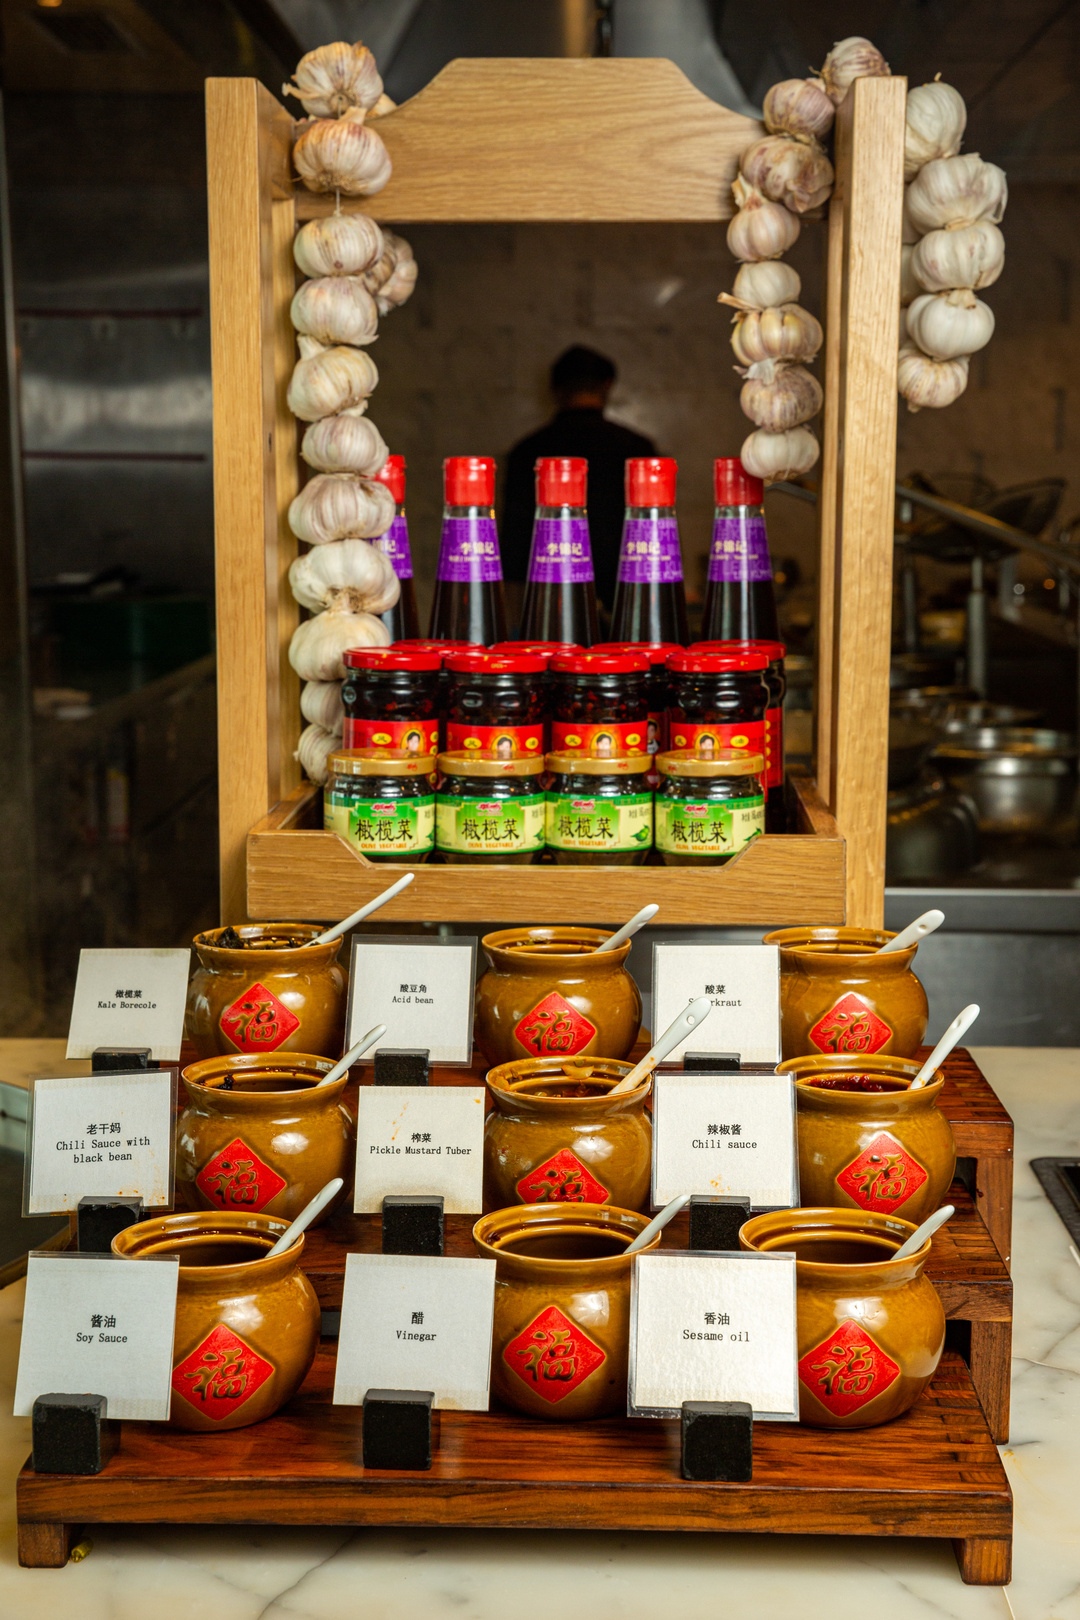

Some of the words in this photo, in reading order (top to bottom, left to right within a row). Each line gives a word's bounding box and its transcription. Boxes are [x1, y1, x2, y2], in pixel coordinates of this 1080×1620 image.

[355, 819, 413, 841] 橄榄菜
[462, 818, 519, 840] 橄榄菜
[558, 816, 614, 839] 橄榄菜
[671, 820, 727, 843] 橄榄菜
[115, 989, 142, 998] 橄榄菜
[400, 983, 427, 993] 酸豆角
[705, 984, 726, 995] 酸菜
[97, 1001, 116, 1009] Kale
[120, 1001, 157, 1009] Borecole
[392, 995, 411, 1003] Acid
[415, 996, 434, 1004] bean
[688, 998, 742, 1007] Srkraut
[229, 1001, 276, 1043] 福
[525, 1010, 573, 1052] 福
[821, 1011, 870, 1053] 福
[86, 1122, 121, 1135] 老干妈
[707, 1123, 742, 1136] 辣椒酱
[56, 1140, 85, 1151] Chili
[91, 1139, 121, 1149] Sauce
[127, 1136, 151, 1147] with
[411, 1132, 431, 1143] 榨菜
[692, 1139, 721, 1149] Chili
[728, 1141, 757, 1149] sauce
[370, 1146, 401, 1155] Pickle
[405, 1146, 441, 1155] Mustard
[446, 1146, 472, 1155] Tuber
[74, 1153, 103, 1164] black
[109, 1152, 132, 1161] bean
[207, 1160, 258, 1204] 福
[853, 1154, 907, 1201] 福
[90, 1314, 117, 1328] 酱油
[411, 1311, 424, 1325] 醋
[704, 1311, 730, 1326] 香油
[76, 1332, 94, 1344] Soy
[99, 1332, 128, 1343] Sauce
[396, 1330, 437, 1342] Vinegar
[683, 1329, 724, 1341] Sesame
[730, 1331, 750, 1343] oil
[517, 1330, 575, 1382] 福
[184, 1348, 247, 1401] 福
[811, 1345, 874, 1395] 福
